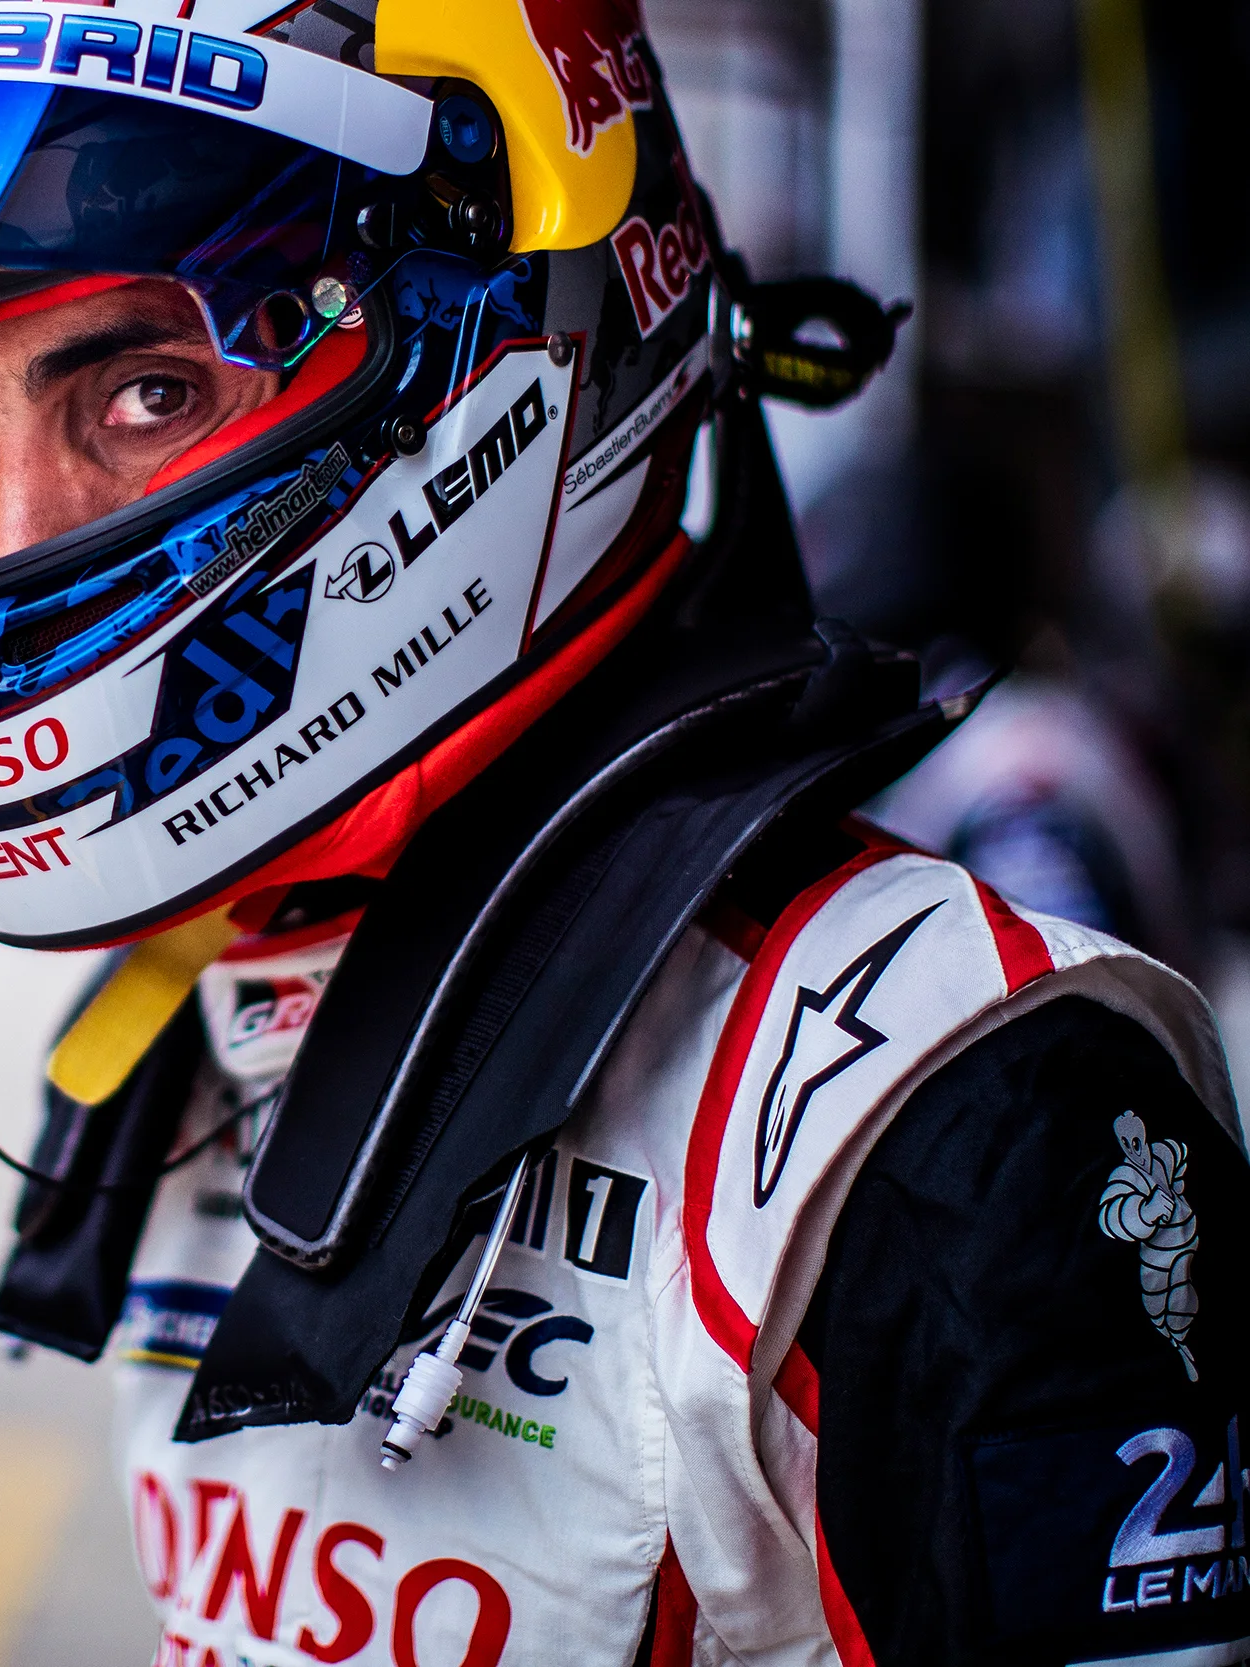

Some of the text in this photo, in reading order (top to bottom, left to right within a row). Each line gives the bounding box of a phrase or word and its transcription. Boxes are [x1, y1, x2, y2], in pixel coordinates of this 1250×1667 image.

[161, 577, 493, 846] RICHARD MILLE
[1102, 1556, 1250, 1612] LE MAN
